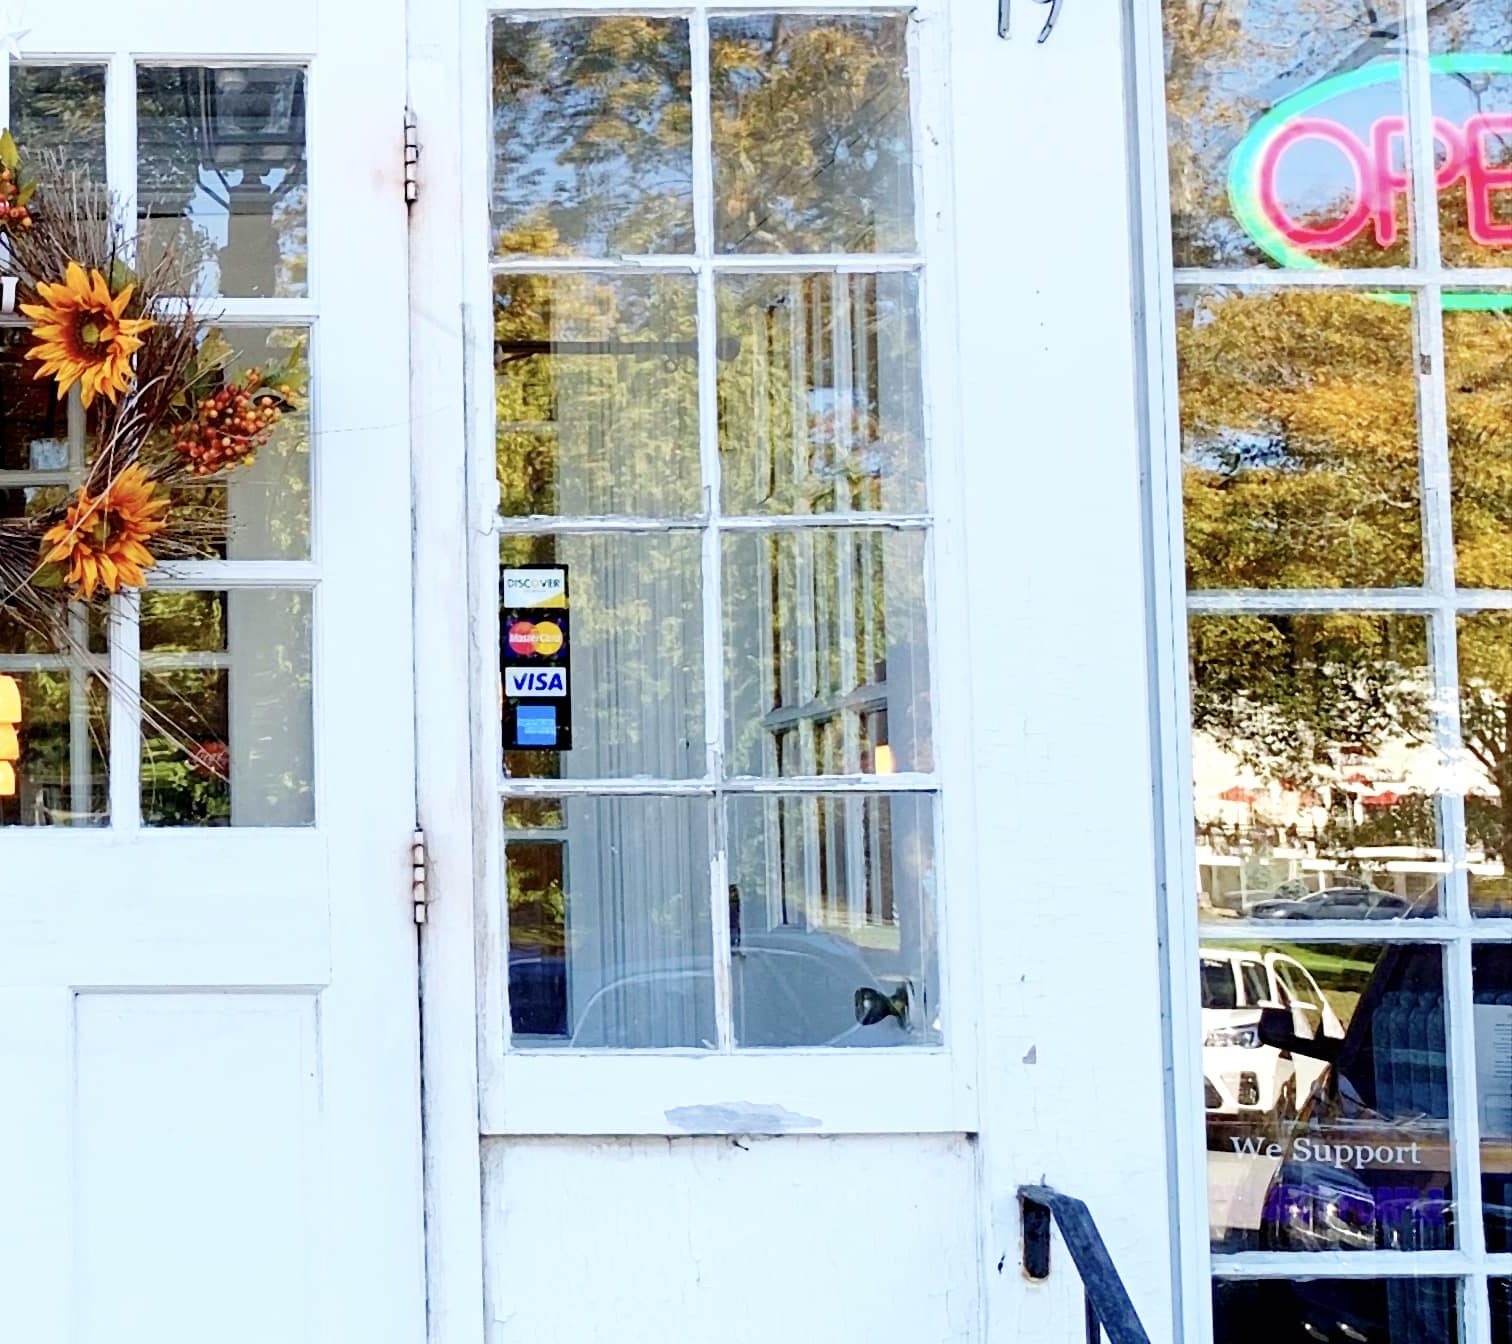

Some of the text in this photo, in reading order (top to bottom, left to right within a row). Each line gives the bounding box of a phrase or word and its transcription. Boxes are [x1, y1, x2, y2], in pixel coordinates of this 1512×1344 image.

[512, 672, 563, 691] VISA
[1229, 1136, 1421, 1169] We Support
